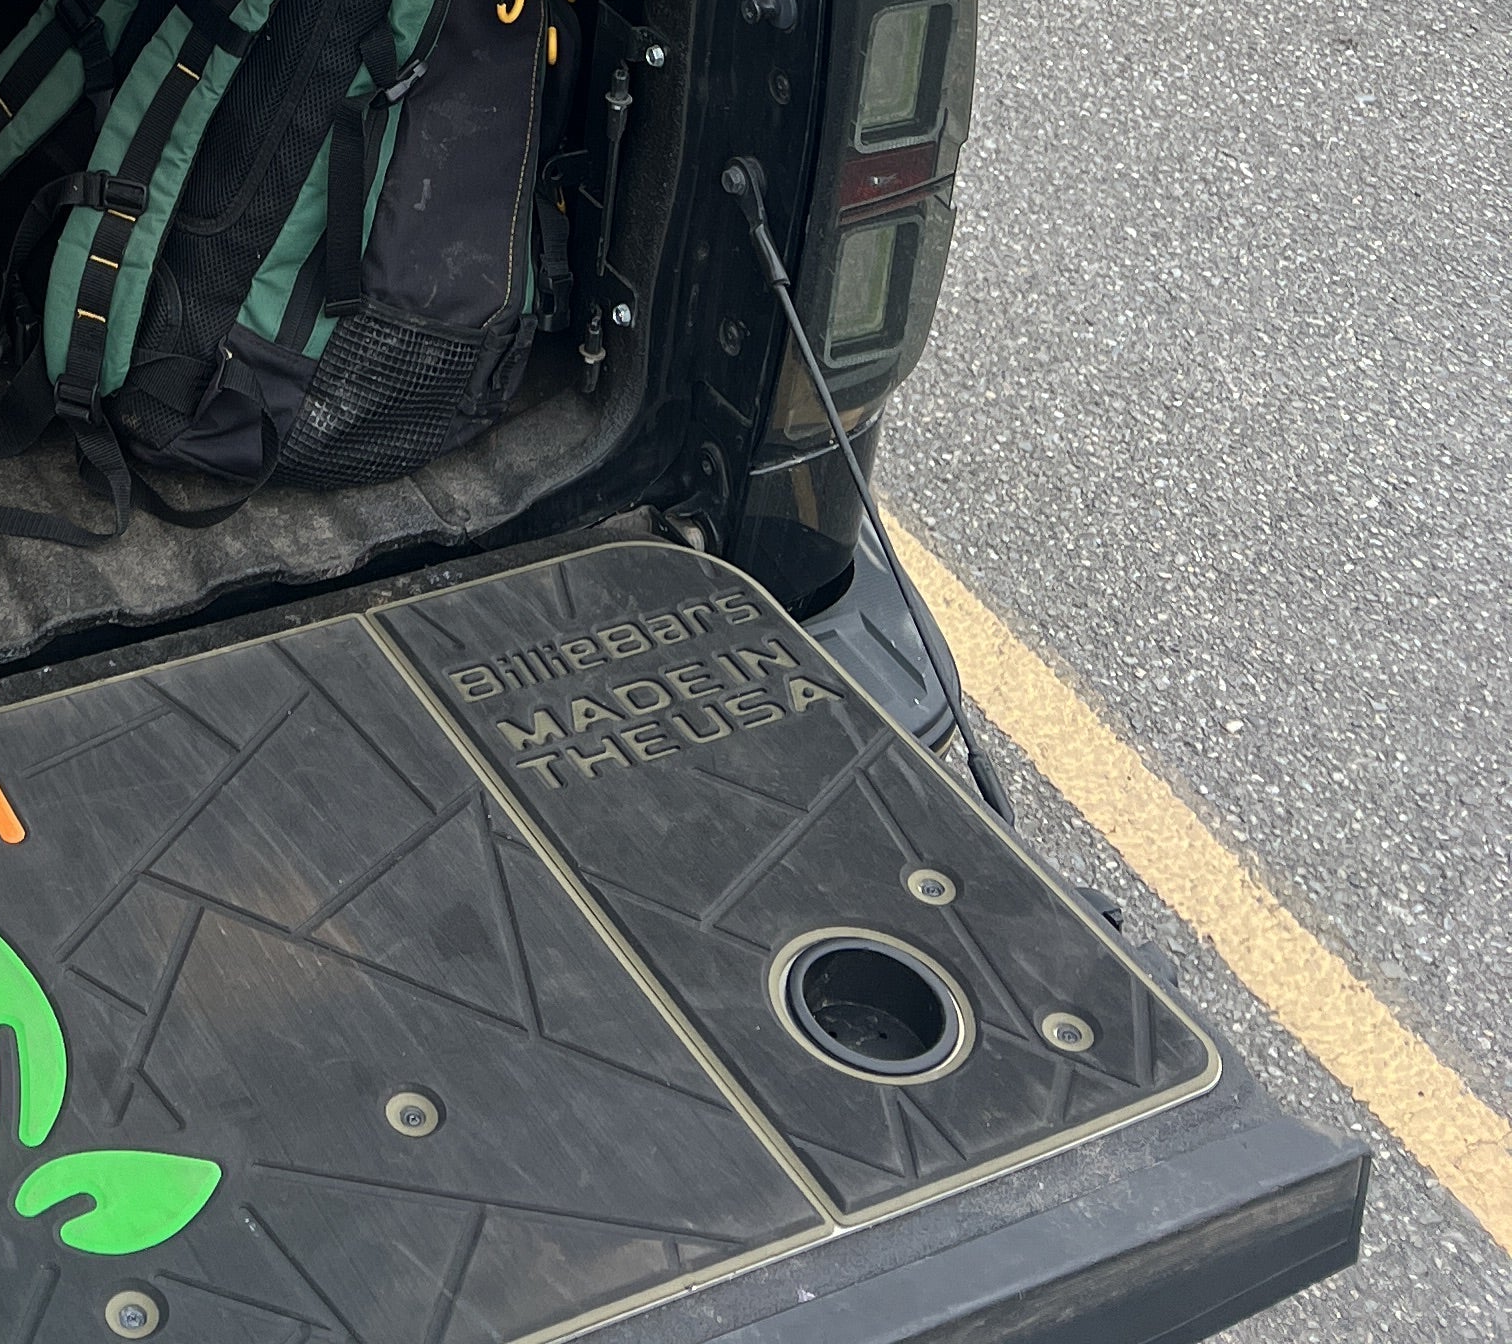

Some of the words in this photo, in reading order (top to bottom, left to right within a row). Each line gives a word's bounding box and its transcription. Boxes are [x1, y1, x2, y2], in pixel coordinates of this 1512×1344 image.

[447, 590, 762, 703] BillieBars
[496, 661, 724, 751] MADE
[717, 637, 801, 683] IN
[515, 720, 681, 790] THE
[673, 676, 845, 744] USA
